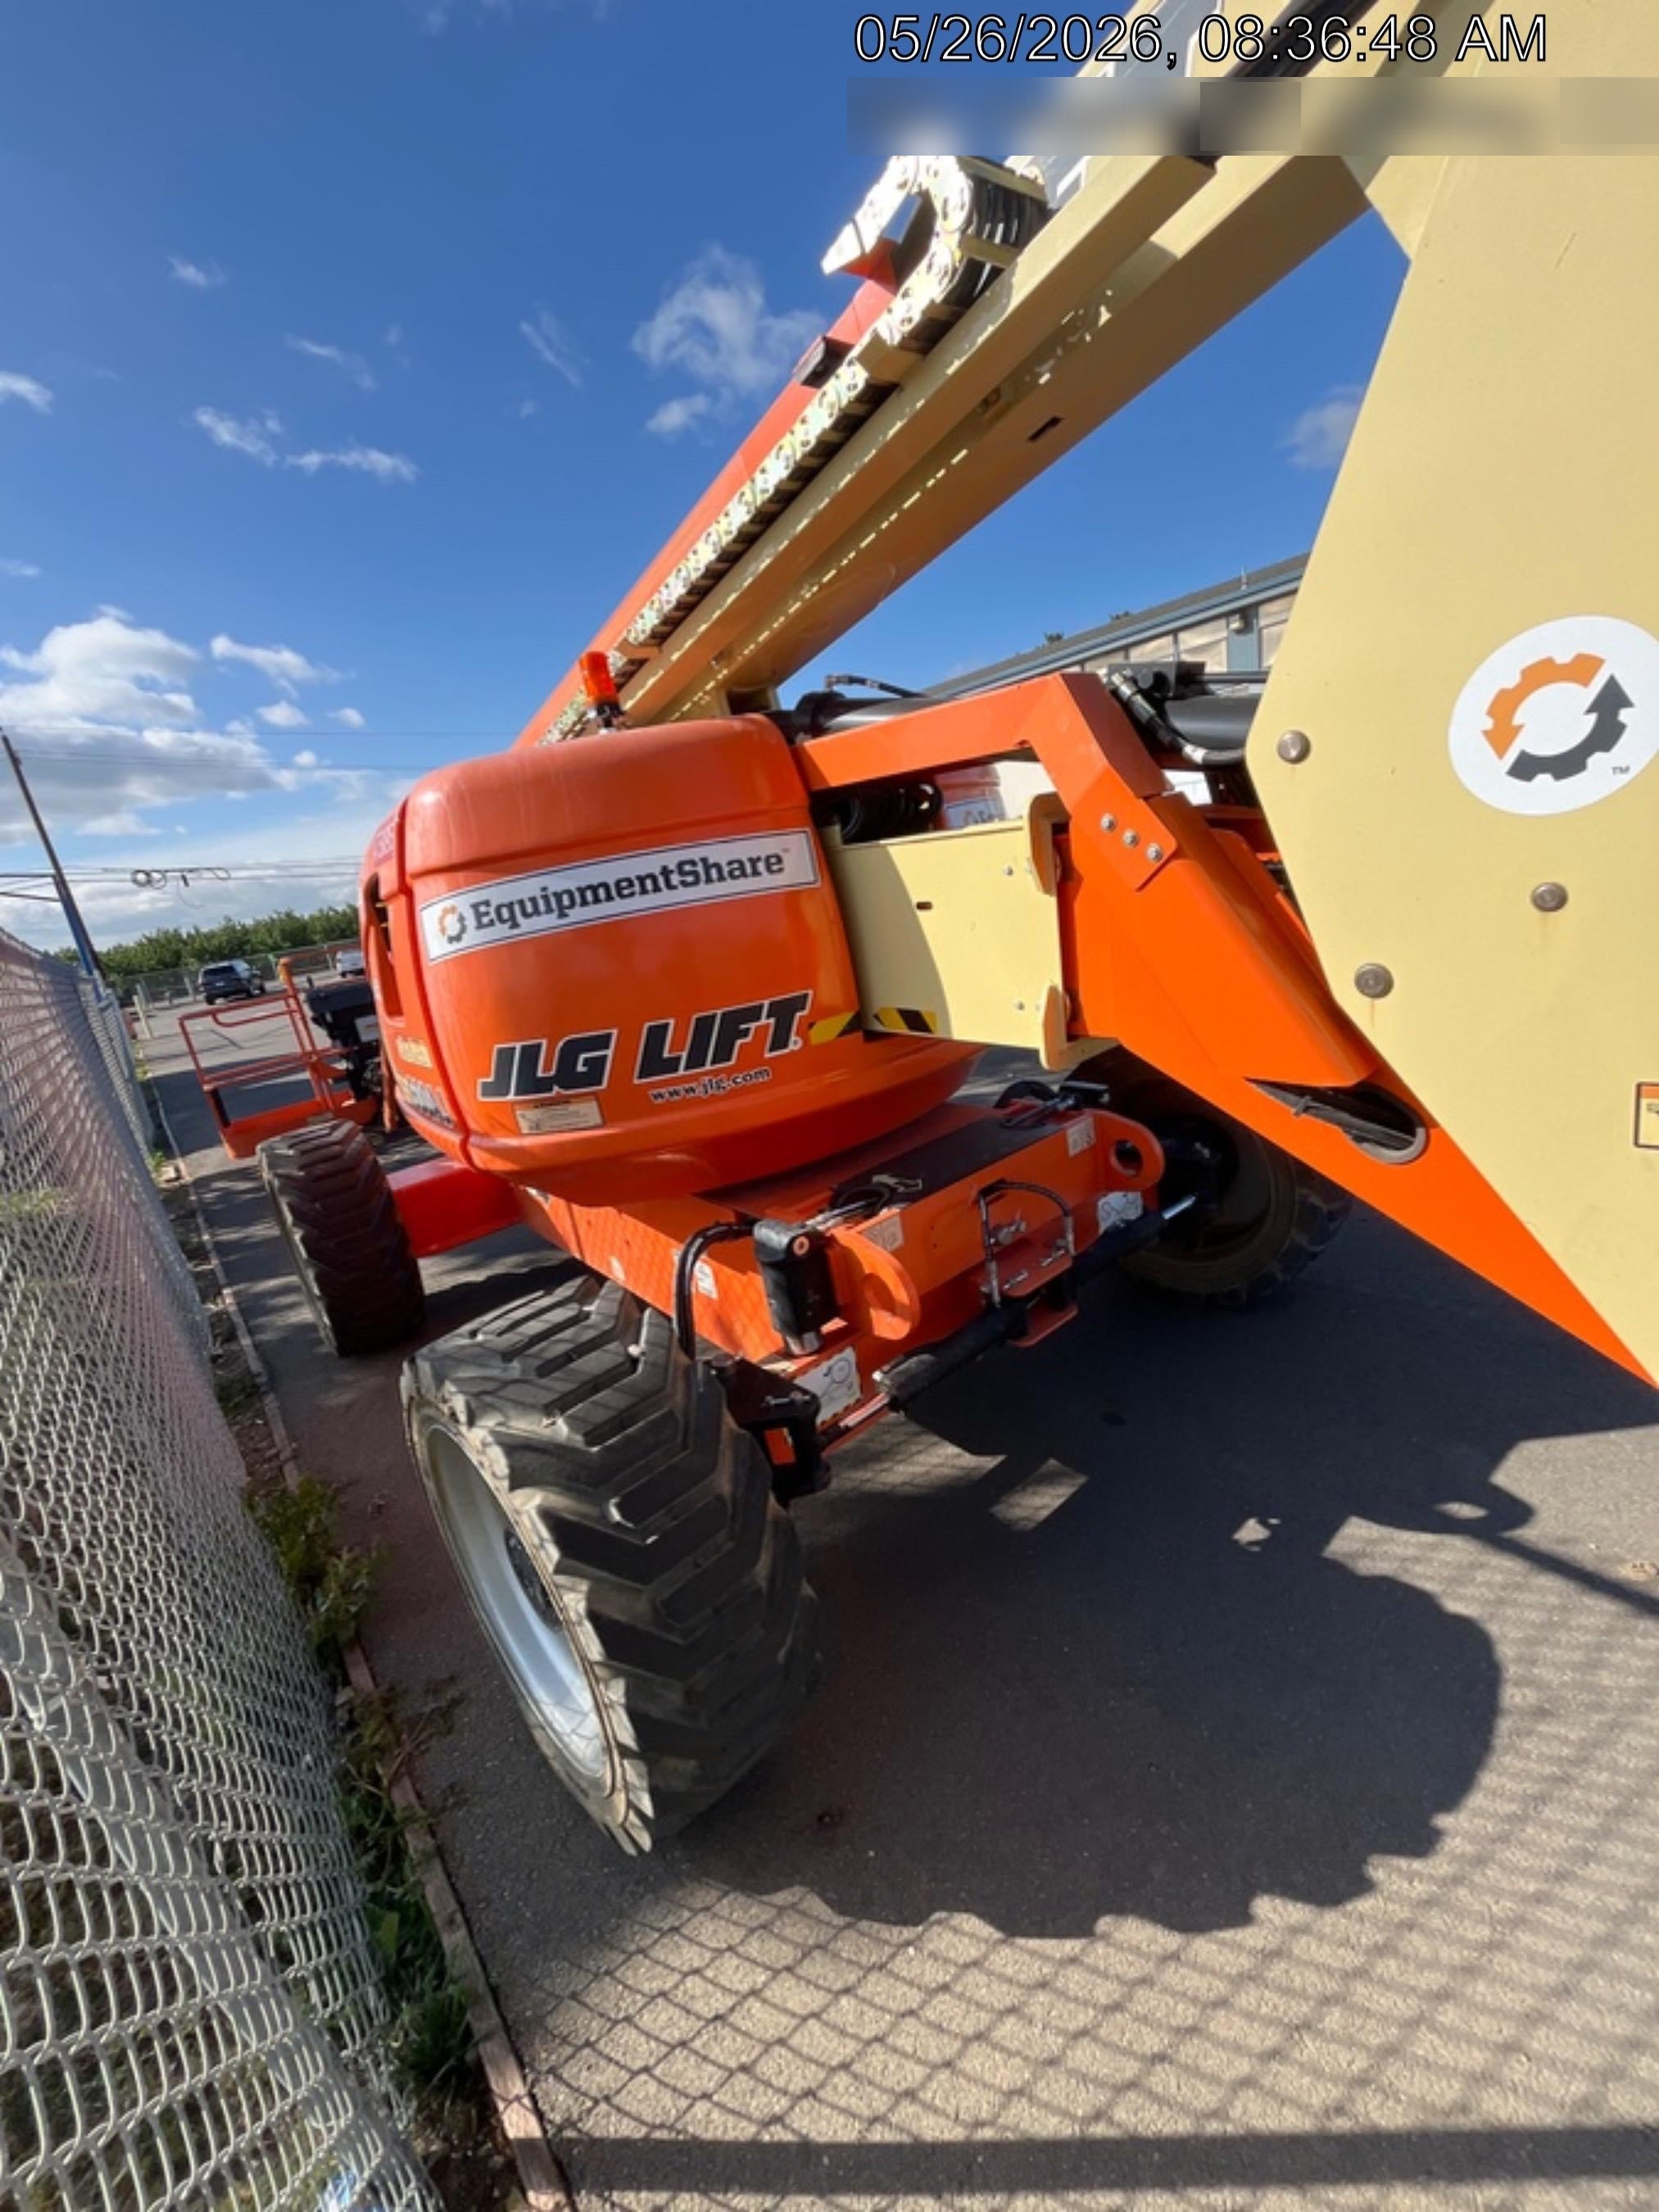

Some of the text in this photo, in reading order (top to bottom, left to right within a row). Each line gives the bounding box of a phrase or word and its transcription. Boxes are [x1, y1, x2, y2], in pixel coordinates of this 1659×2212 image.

[471, 851, 784, 931] EquipmentShare
[478, 990, 813, 1100] JLG LIFT
[650, 1067, 772, 1104] www.jlg.com
